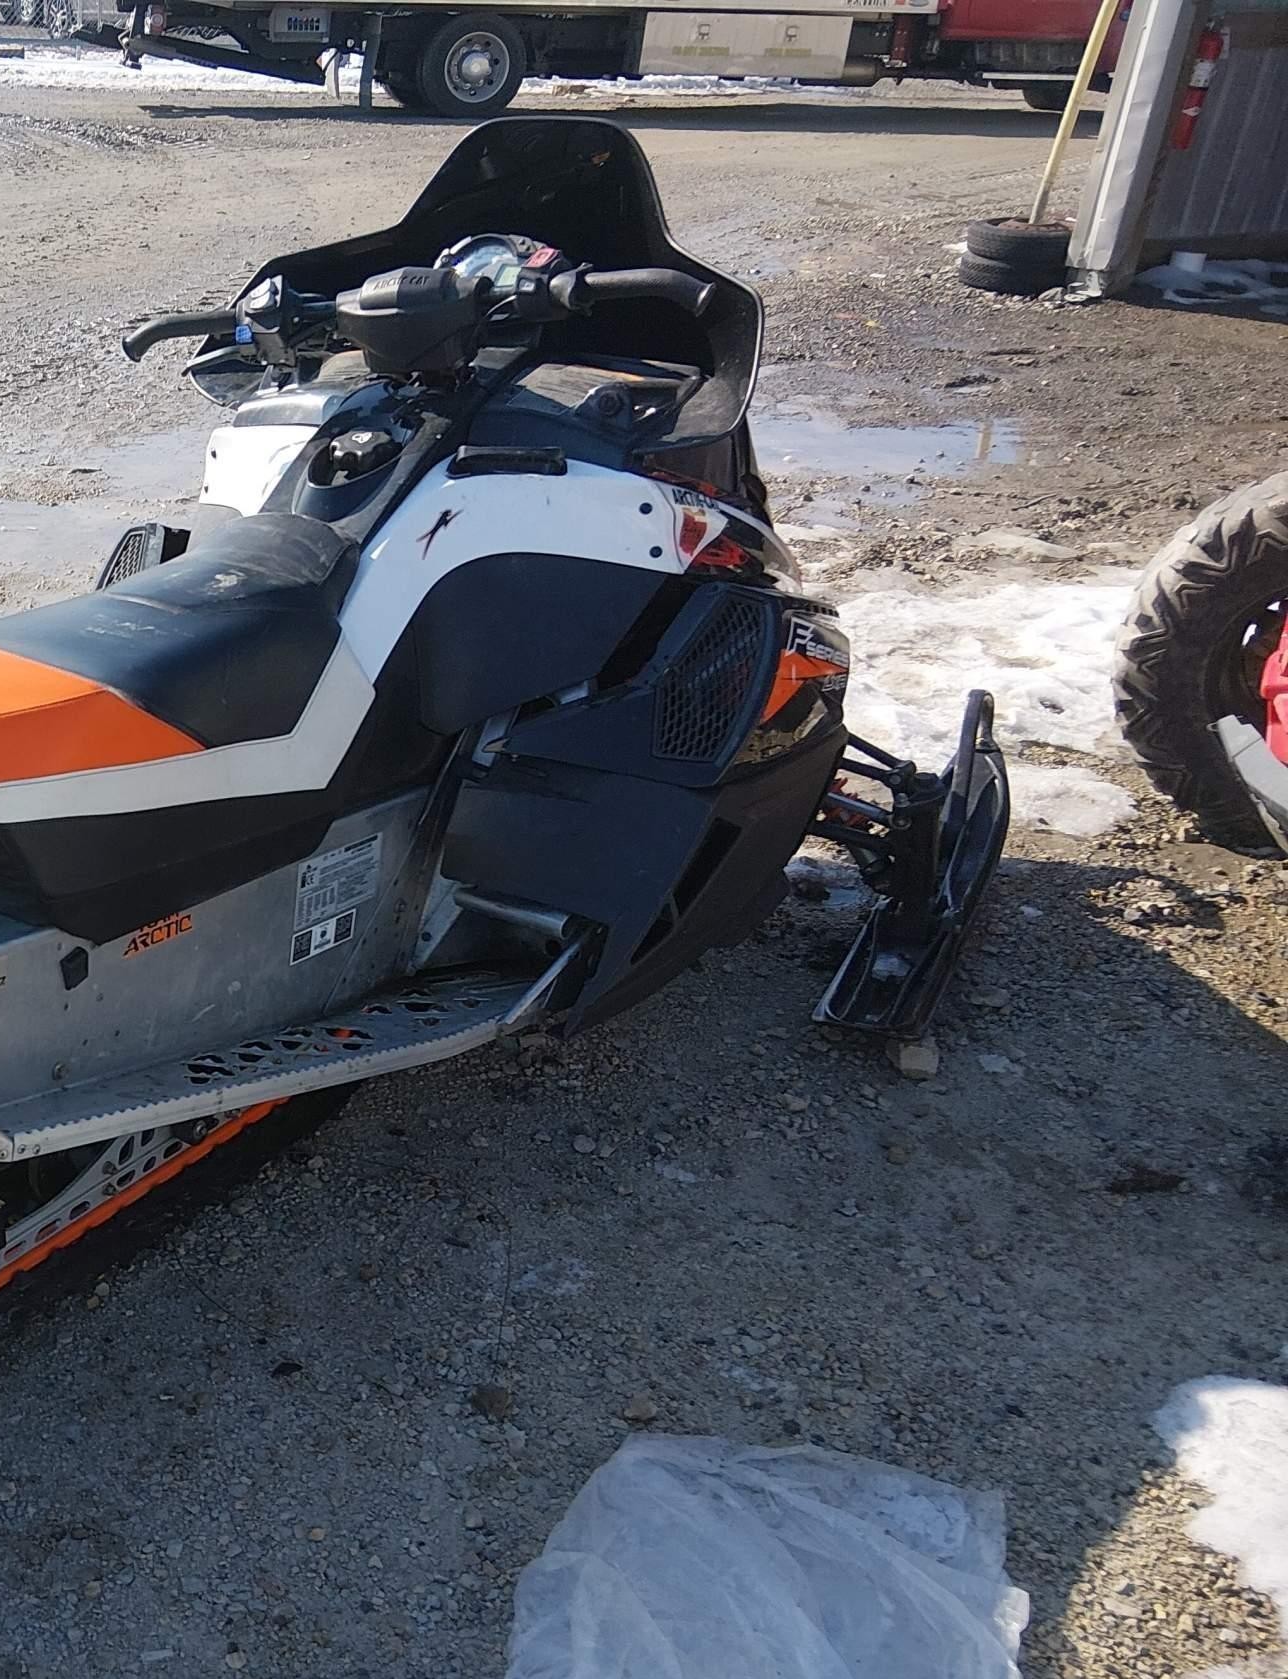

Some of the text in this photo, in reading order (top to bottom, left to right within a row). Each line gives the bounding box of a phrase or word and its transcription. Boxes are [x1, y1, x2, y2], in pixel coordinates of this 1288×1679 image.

[374, 275, 430, 290] ARCTIC CAT
[123, 914, 193, 956] ARCTIC
